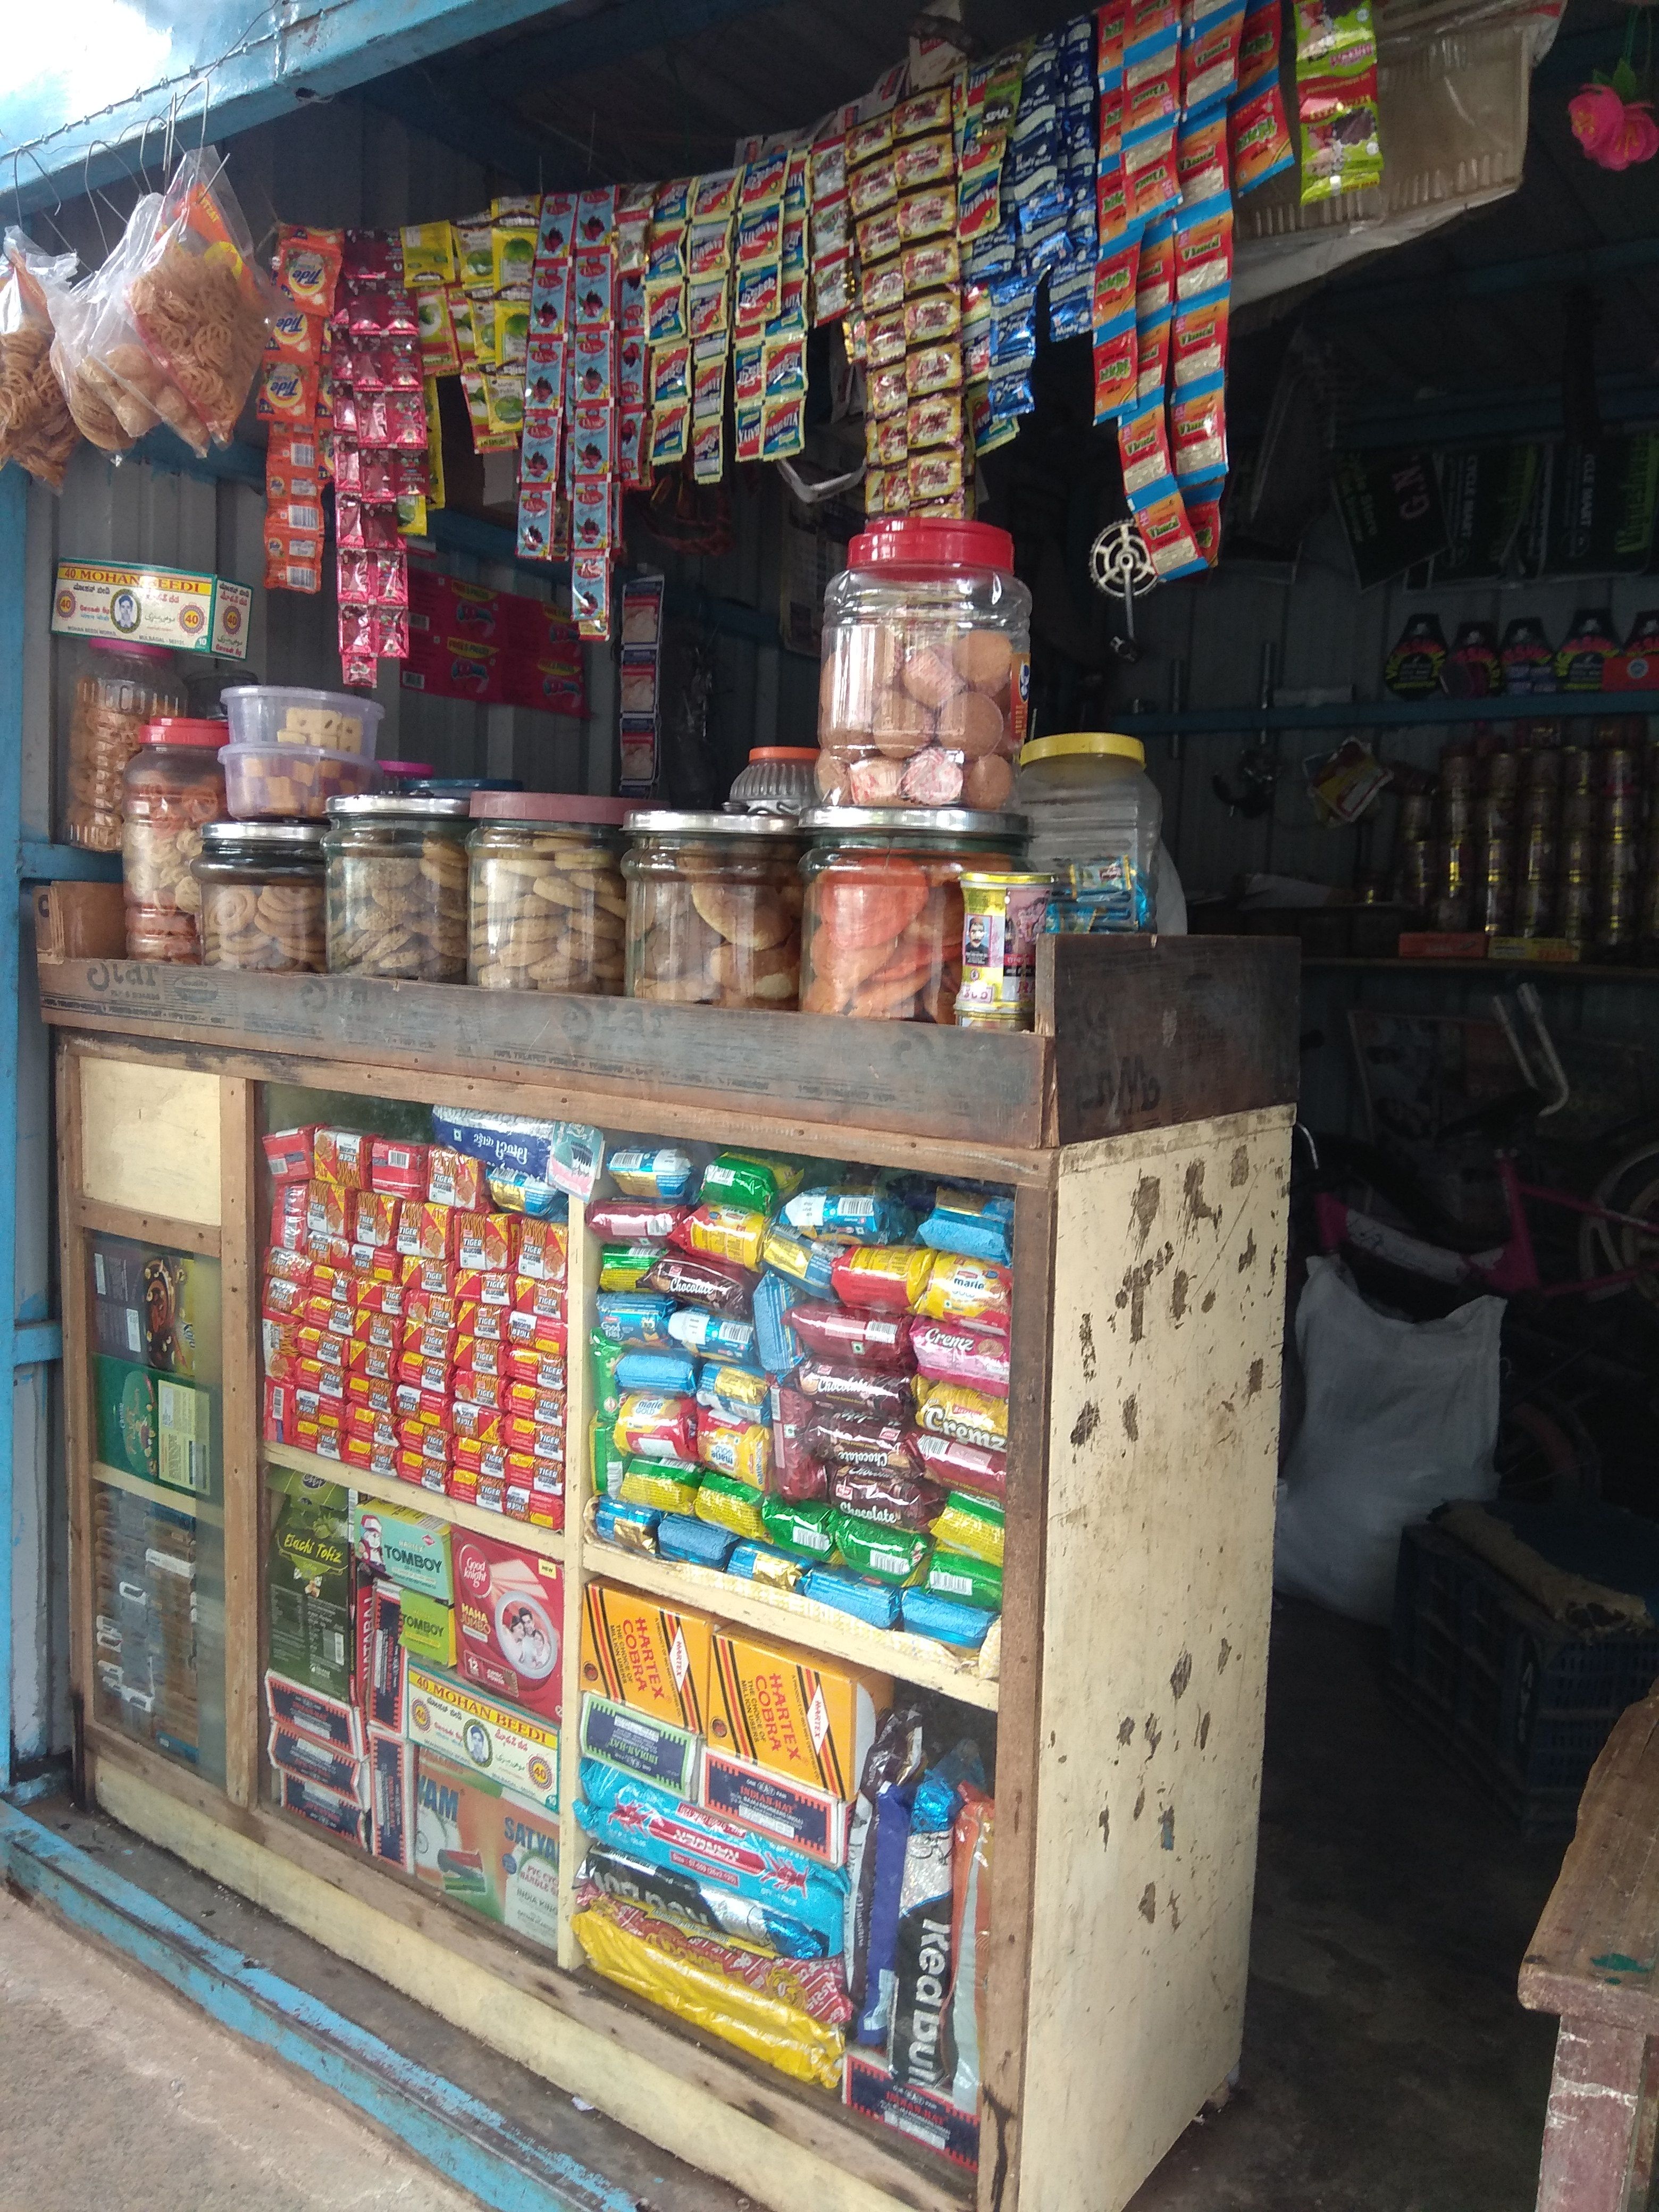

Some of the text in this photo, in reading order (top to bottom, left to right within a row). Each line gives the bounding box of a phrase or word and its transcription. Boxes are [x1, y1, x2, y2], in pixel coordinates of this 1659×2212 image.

[292, 269, 321, 284] Tide
[275, 315, 303, 333] Tide
[271, 379, 298, 397] Tide
[65, 569, 76, 578] 40
[80, 571, 140, 584] MOHAN
[339, 1152, 357, 1162] TIGER
[434, 1175, 453, 1183] TIGER
[311, 1203, 325, 1212] TIGER
[360, 1215, 374, 1224] TIGER
[524, 1244, 542, 1254] TIGER
[487, 1280, 505, 1289] TIGER
[669, 1277, 715, 1295] Chocolate
[953, 1276, 985, 1291] marie
[539, 1297, 557, 1306] TIGER
[432, 1310, 449, 1319] TIGER
[479, 1317, 496, 1326] TIGER
[512, 1329, 530, 1339] TIGER
[426, 1336, 442, 1344] TIGER
[925, 1328, 974, 1352] Cremz
[322, 1342, 339, 1351] TIGER
[476, 1353, 493, 1362] TIGER
[369, 1359, 386, 1367] TIGER
[426, 1367, 442, 1375] TIGER
[542, 1365, 563, 1374] TIGER
[477, 1389, 494, 1398] TIGER
[540, 1400, 558, 1409] TIGER
[638, 1400, 663, 1410] marie
[457, 1417, 473, 1427] TIGER
[924, 1405, 1007, 1452] Cremz
[427, 1436, 442, 1445] TIGER
[541, 1435, 559, 1444] TIGER
[485, 1453, 503, 1463] TIGER
[839, 1450, 888, 1468] Chocolate
[426, 1468, 441, 1478] TIGER
[539, 1468, 557, 1477] TIGER
[482, 1486, 500, 1496] TIGER
[840, 1501, 898, 1524] Chocolate
[284, 1534, 315, 1554] Elachi
[384, 1544, 442, 1573] TOMBOY
[466, 1557, 486, 1571] Good
[464, 1568, 487, 1588] knight
[461, 1602, 489, 1623] MAHA
[403, 1614, 445, 1637] TOMBOY
[623, 1618, 648, 1692] COBRA
[634, 1616, 665, 1701] HARTEX
[433, 1685, 490, 1719] MOHAN
[496, 1713, 546, 1743] BEEDI
[750, 1696, 764, 1729] CHOICE
[756, 1674, 782, 1753] COBRA
[769, 1672, 801, 1761] HARTEX
